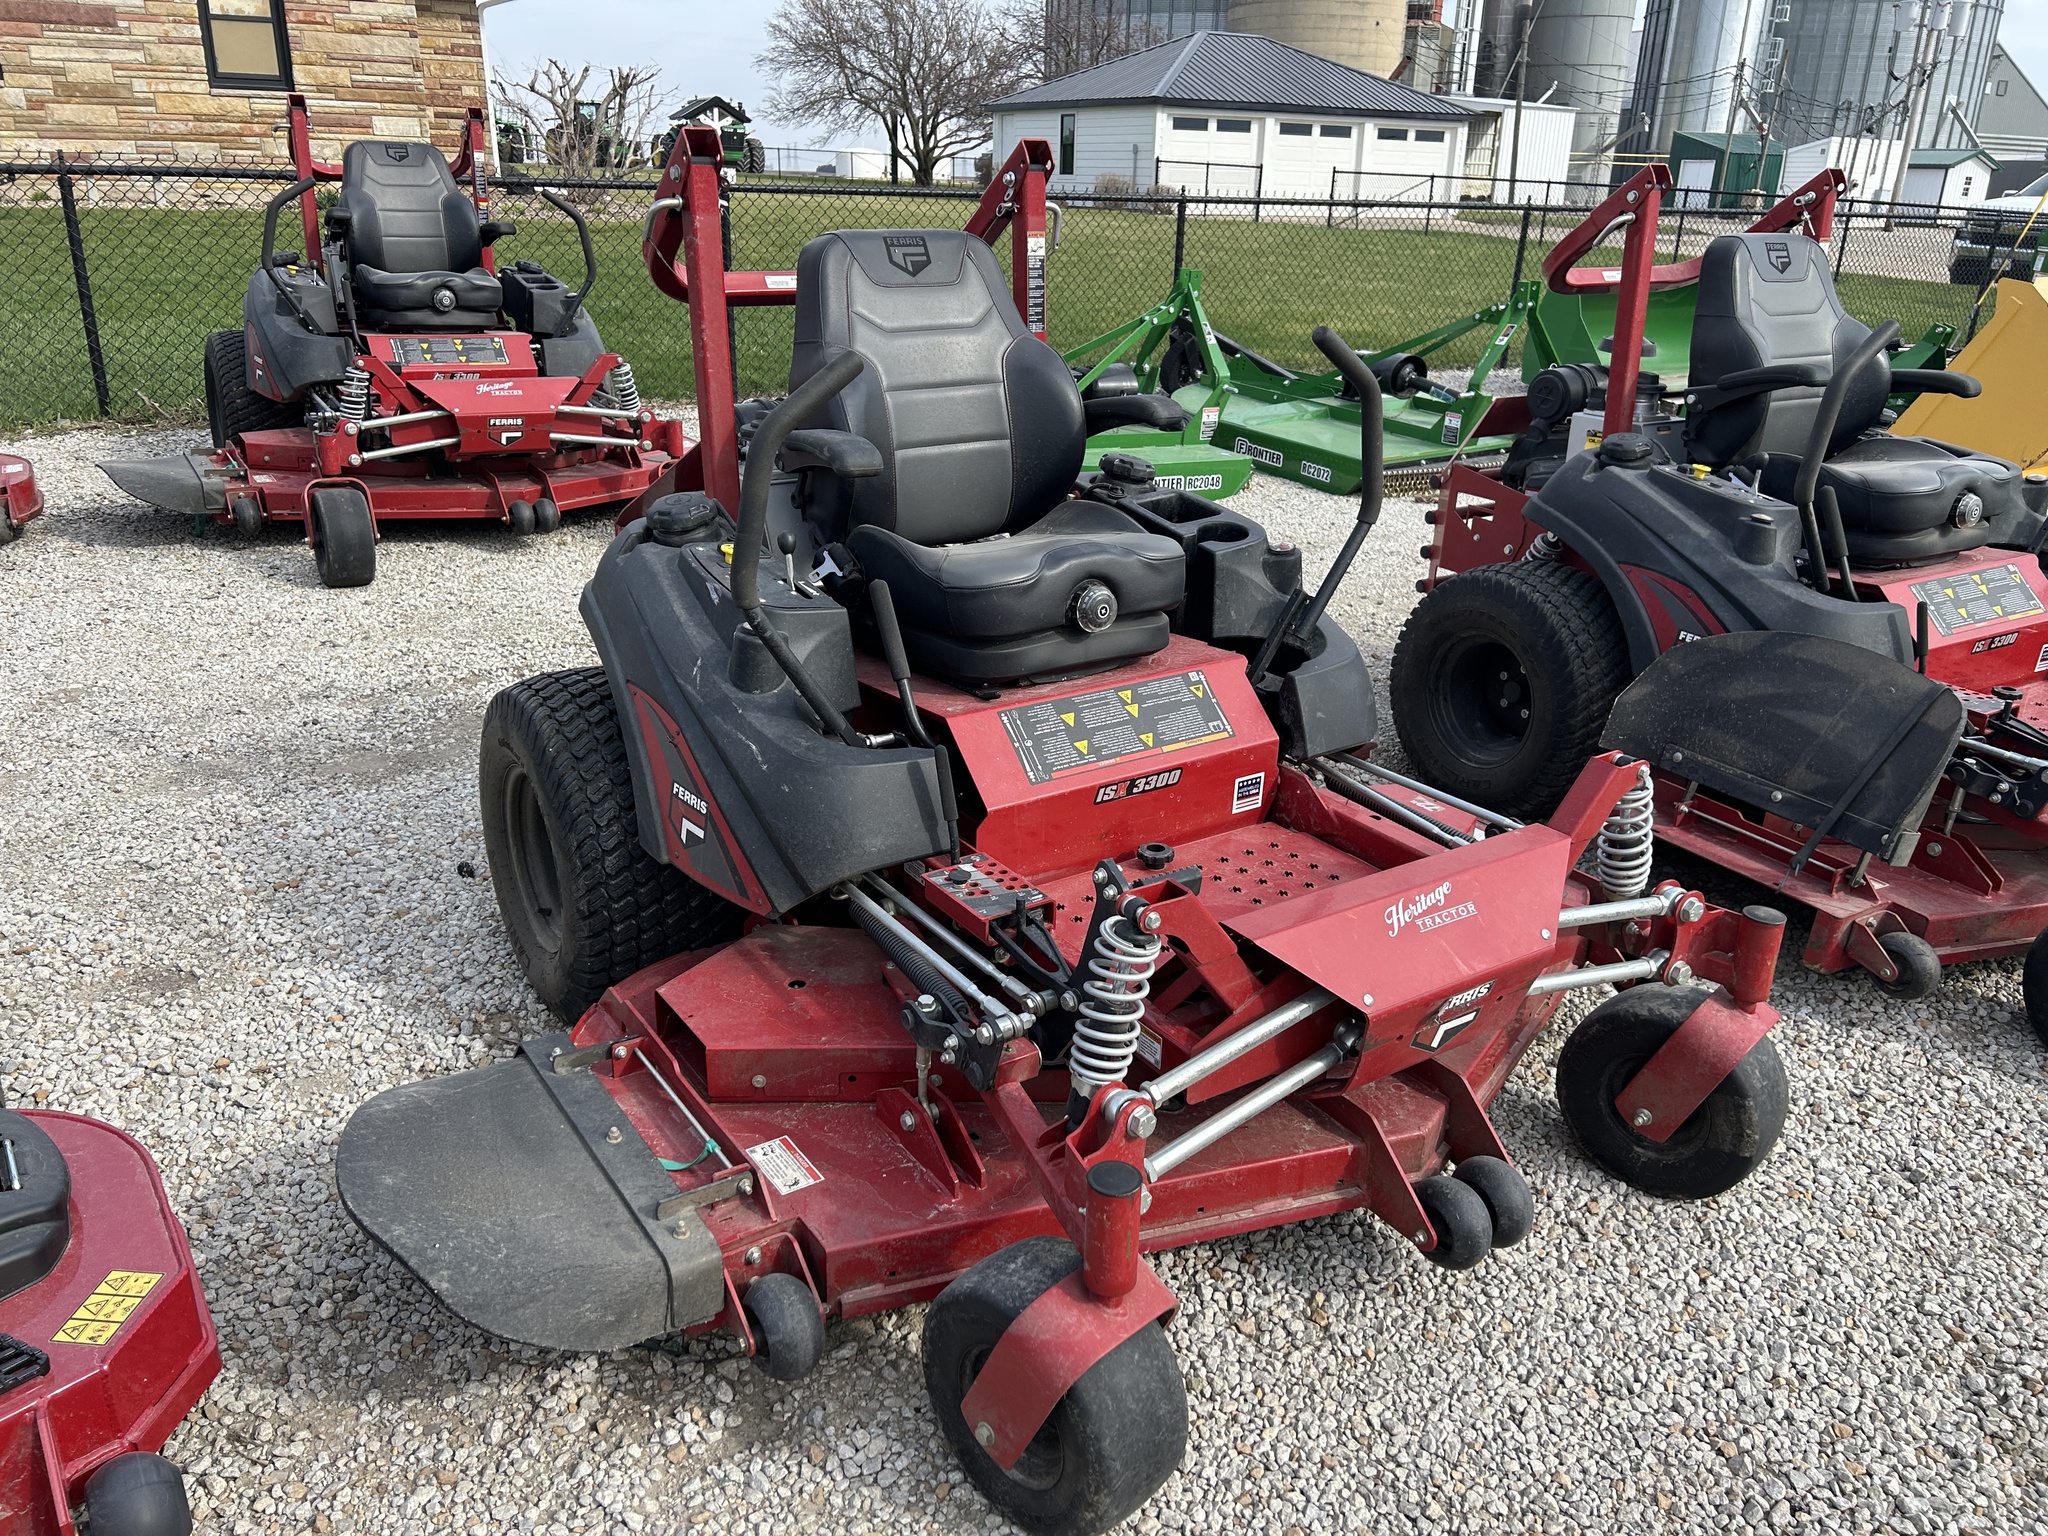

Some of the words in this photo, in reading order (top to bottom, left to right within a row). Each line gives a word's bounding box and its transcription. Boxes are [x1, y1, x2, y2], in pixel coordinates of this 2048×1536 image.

[886, 237, 924, 245] FERRIS
[476, 381, 514, 395] Heritage
[490, 418, 523, 426] FERRIS
[1236, 438, 1282, 466] FRONTIER
[1302, 462, 1331, 481] RC2072
[1154, 477, 1182, 490] NTIER
[1188, 476, 1221, 490] RC2048
[1991, 632, 2019, 648] 3300
[1096, 782, 1130, 802] ISX
[1132, 769, 1182, 794] 3300
[673, 782, 707, 814] FERRIS
[1384, 881, 1452, 937] Heritage
[1416, 903, 1477, 930] TRACTOR
[1448, 984, 1491, 1009] RRIS
